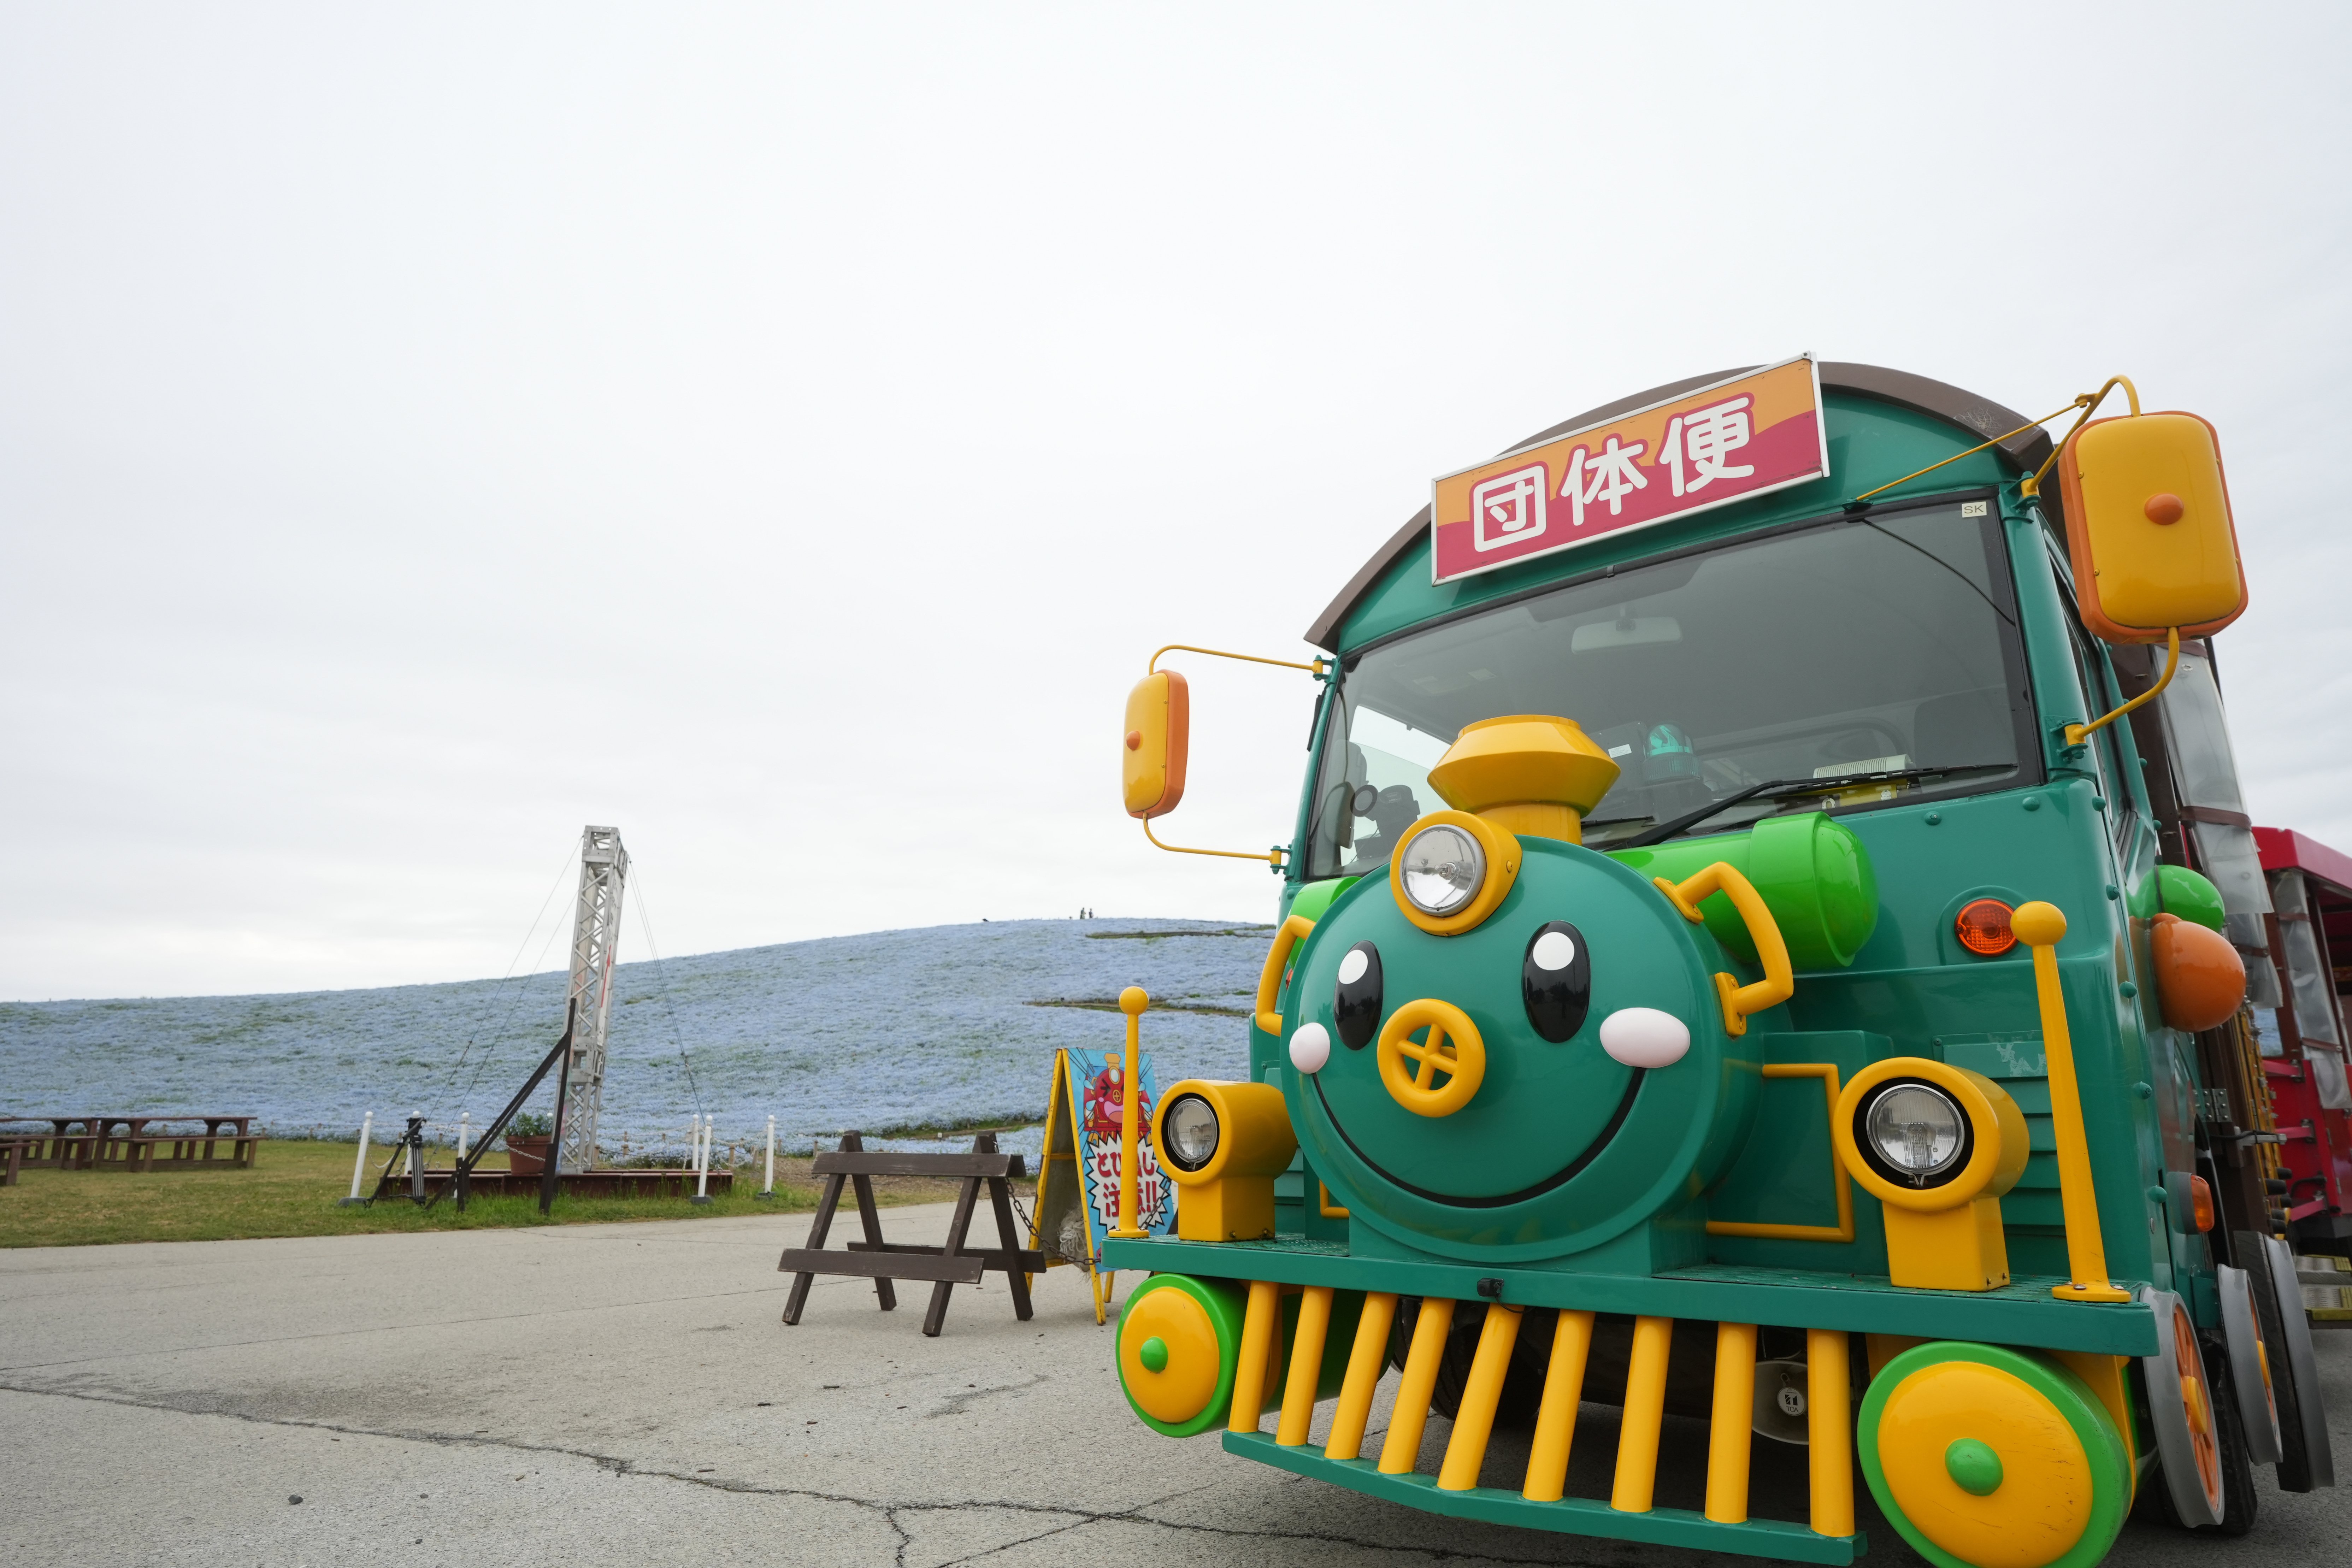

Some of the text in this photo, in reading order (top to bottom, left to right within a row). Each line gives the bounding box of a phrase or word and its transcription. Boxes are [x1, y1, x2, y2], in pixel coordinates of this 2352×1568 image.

[1473, 396, 1755, 552] 団体便
[1964, 505, 1984, 514] SK
[1097, 1151, 1155, 1178] とし
